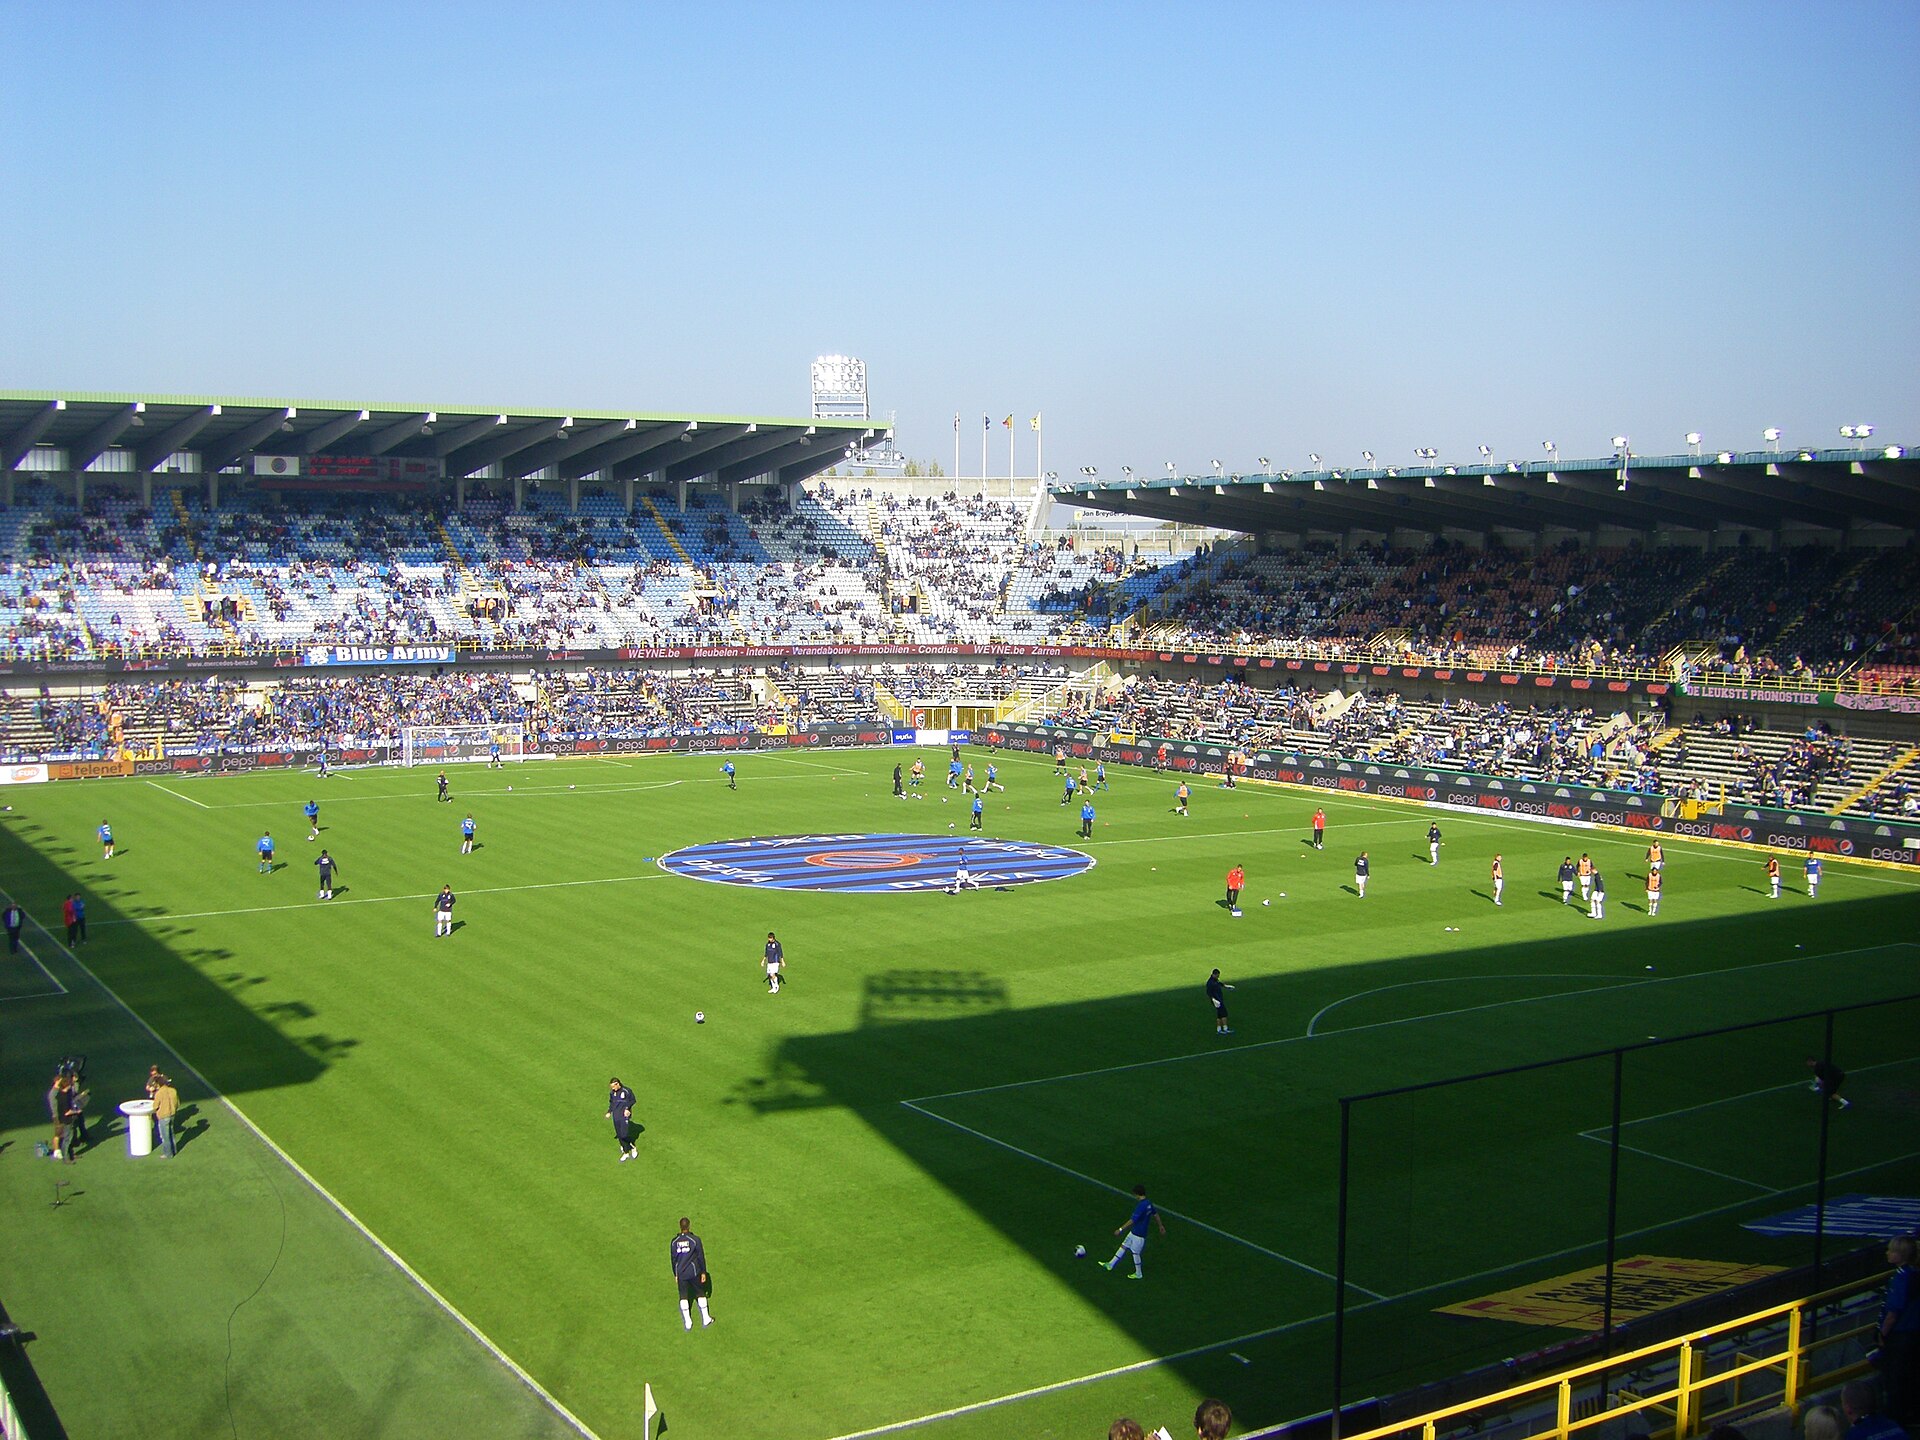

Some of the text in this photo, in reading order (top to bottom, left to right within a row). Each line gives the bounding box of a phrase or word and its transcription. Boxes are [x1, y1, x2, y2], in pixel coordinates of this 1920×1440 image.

[335, 646, 449, 661] Blue Army
[470, 653, 533, 661] www.mercedes-benz.be
[628, 648, 680, 659] WEYNE.be
[694, 647, 738, 658] Meubelen
[745, 646, 784, 656] Interieur
[791, 645, 851, 656] Verandabouw
[973, 645, 1025, 655] WEYNE.be
[1031, 646, 1061, 656] Zarren
[187, 659, 258, 668] www.mercedes-benz.be
[1686, 685, 1819, 705] DE LEUKSTE PRONOSTIEK
[617, 739, 646, 751] pepsi
[689, 737, 717, 749] pepsi
[760, 735, 788, 746] pepsi
[831, 733, 857, 744] pepsi
[544, 741, 574, 753] pepsi
[1100, 748, 1120, 760] pepsi
[136, 760, 172, 773] pepsi
[222, 755, 256, 769] pepsi
[1200, 762, 1222, 774] pepsi
[75, 763, 123, 775] telenet
[1254, 768, 1277, 781] pepsi
[1312, 776, 1338, 788] pepsi
[1377, 784, 1404, 797] pepsi
[1448, 793, 1476, 806] pepsi
[1515, 801, 1545, 815] pepsi
[1591, 811, 1624, 825] pepsi
[1675, 822, 1710, 836] pepsi
[1768, 834, 1840, 853] pepsi MAX
[1871, 847, 1913, 862] pepsi
